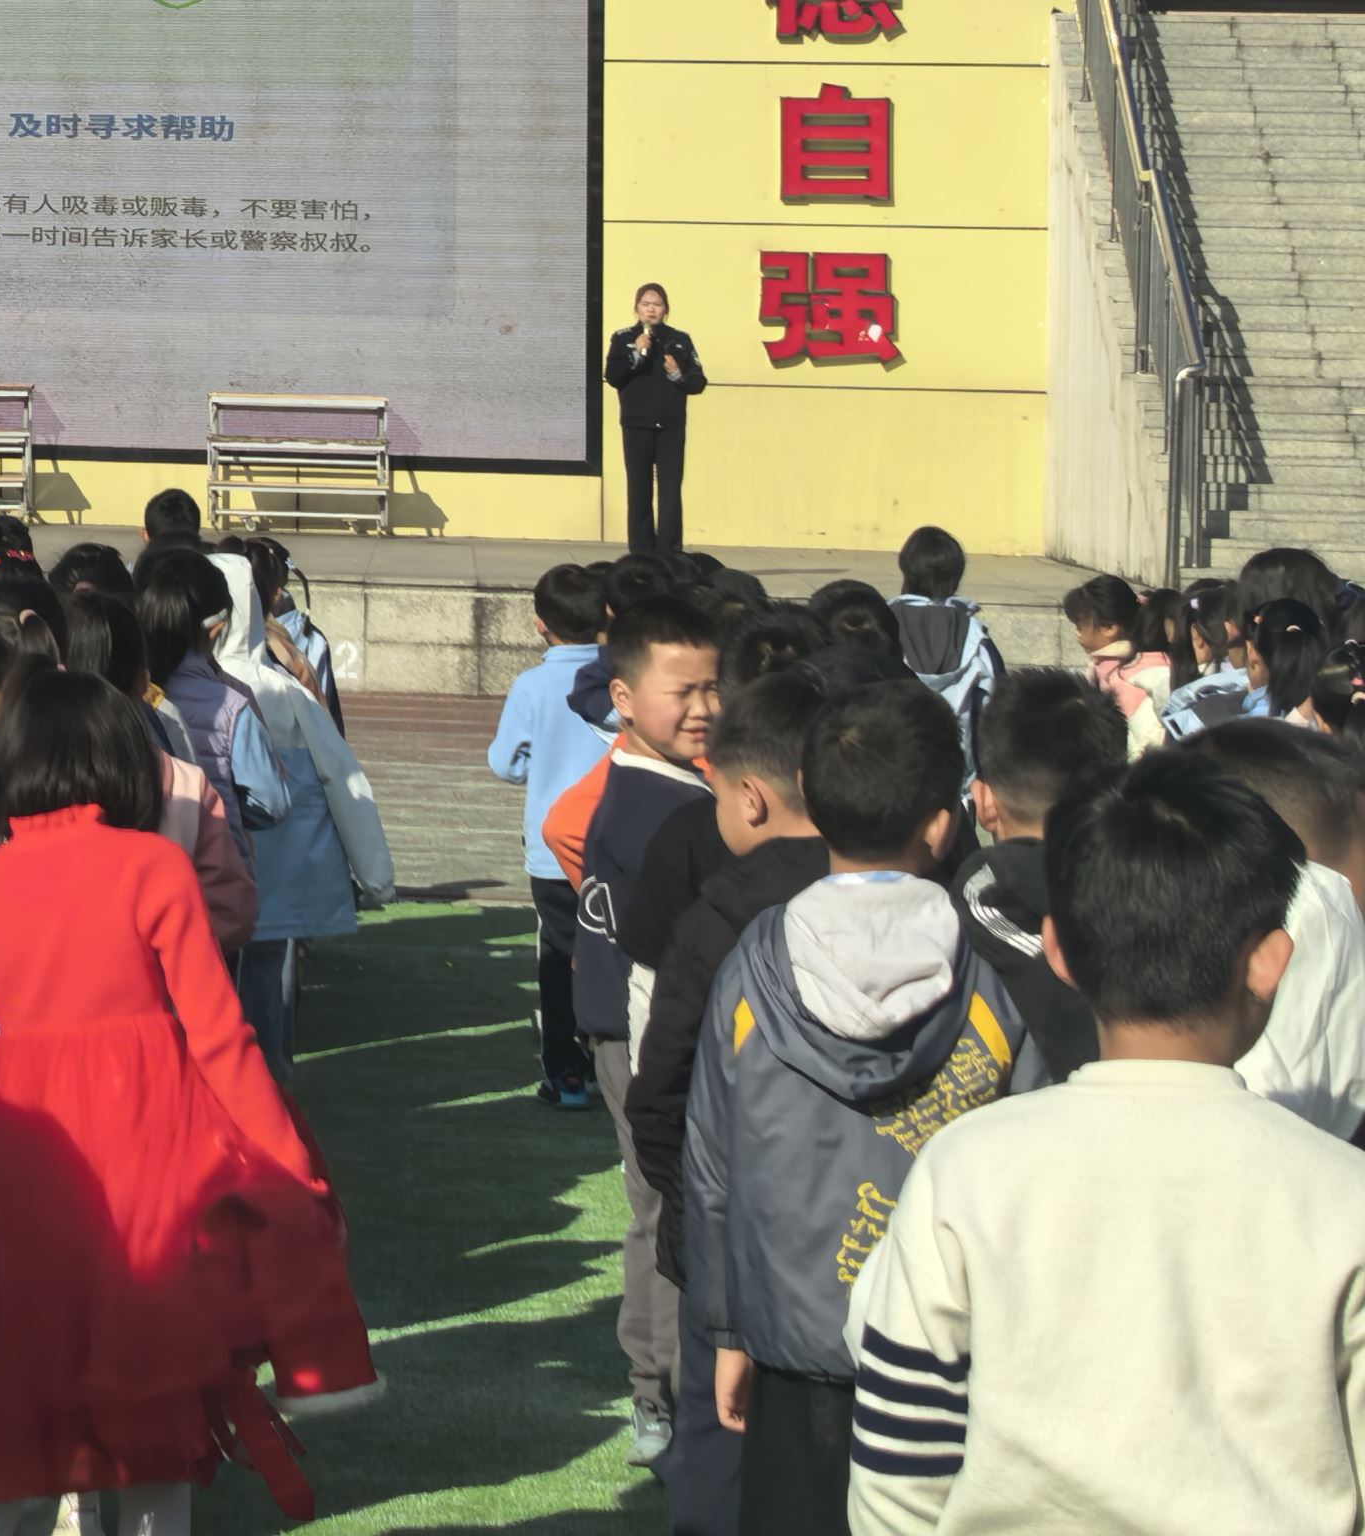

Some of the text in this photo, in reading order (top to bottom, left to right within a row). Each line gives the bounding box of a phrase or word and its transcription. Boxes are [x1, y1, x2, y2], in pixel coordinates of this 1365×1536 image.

[8, 113, 234, 142] 及时寻求帮助
